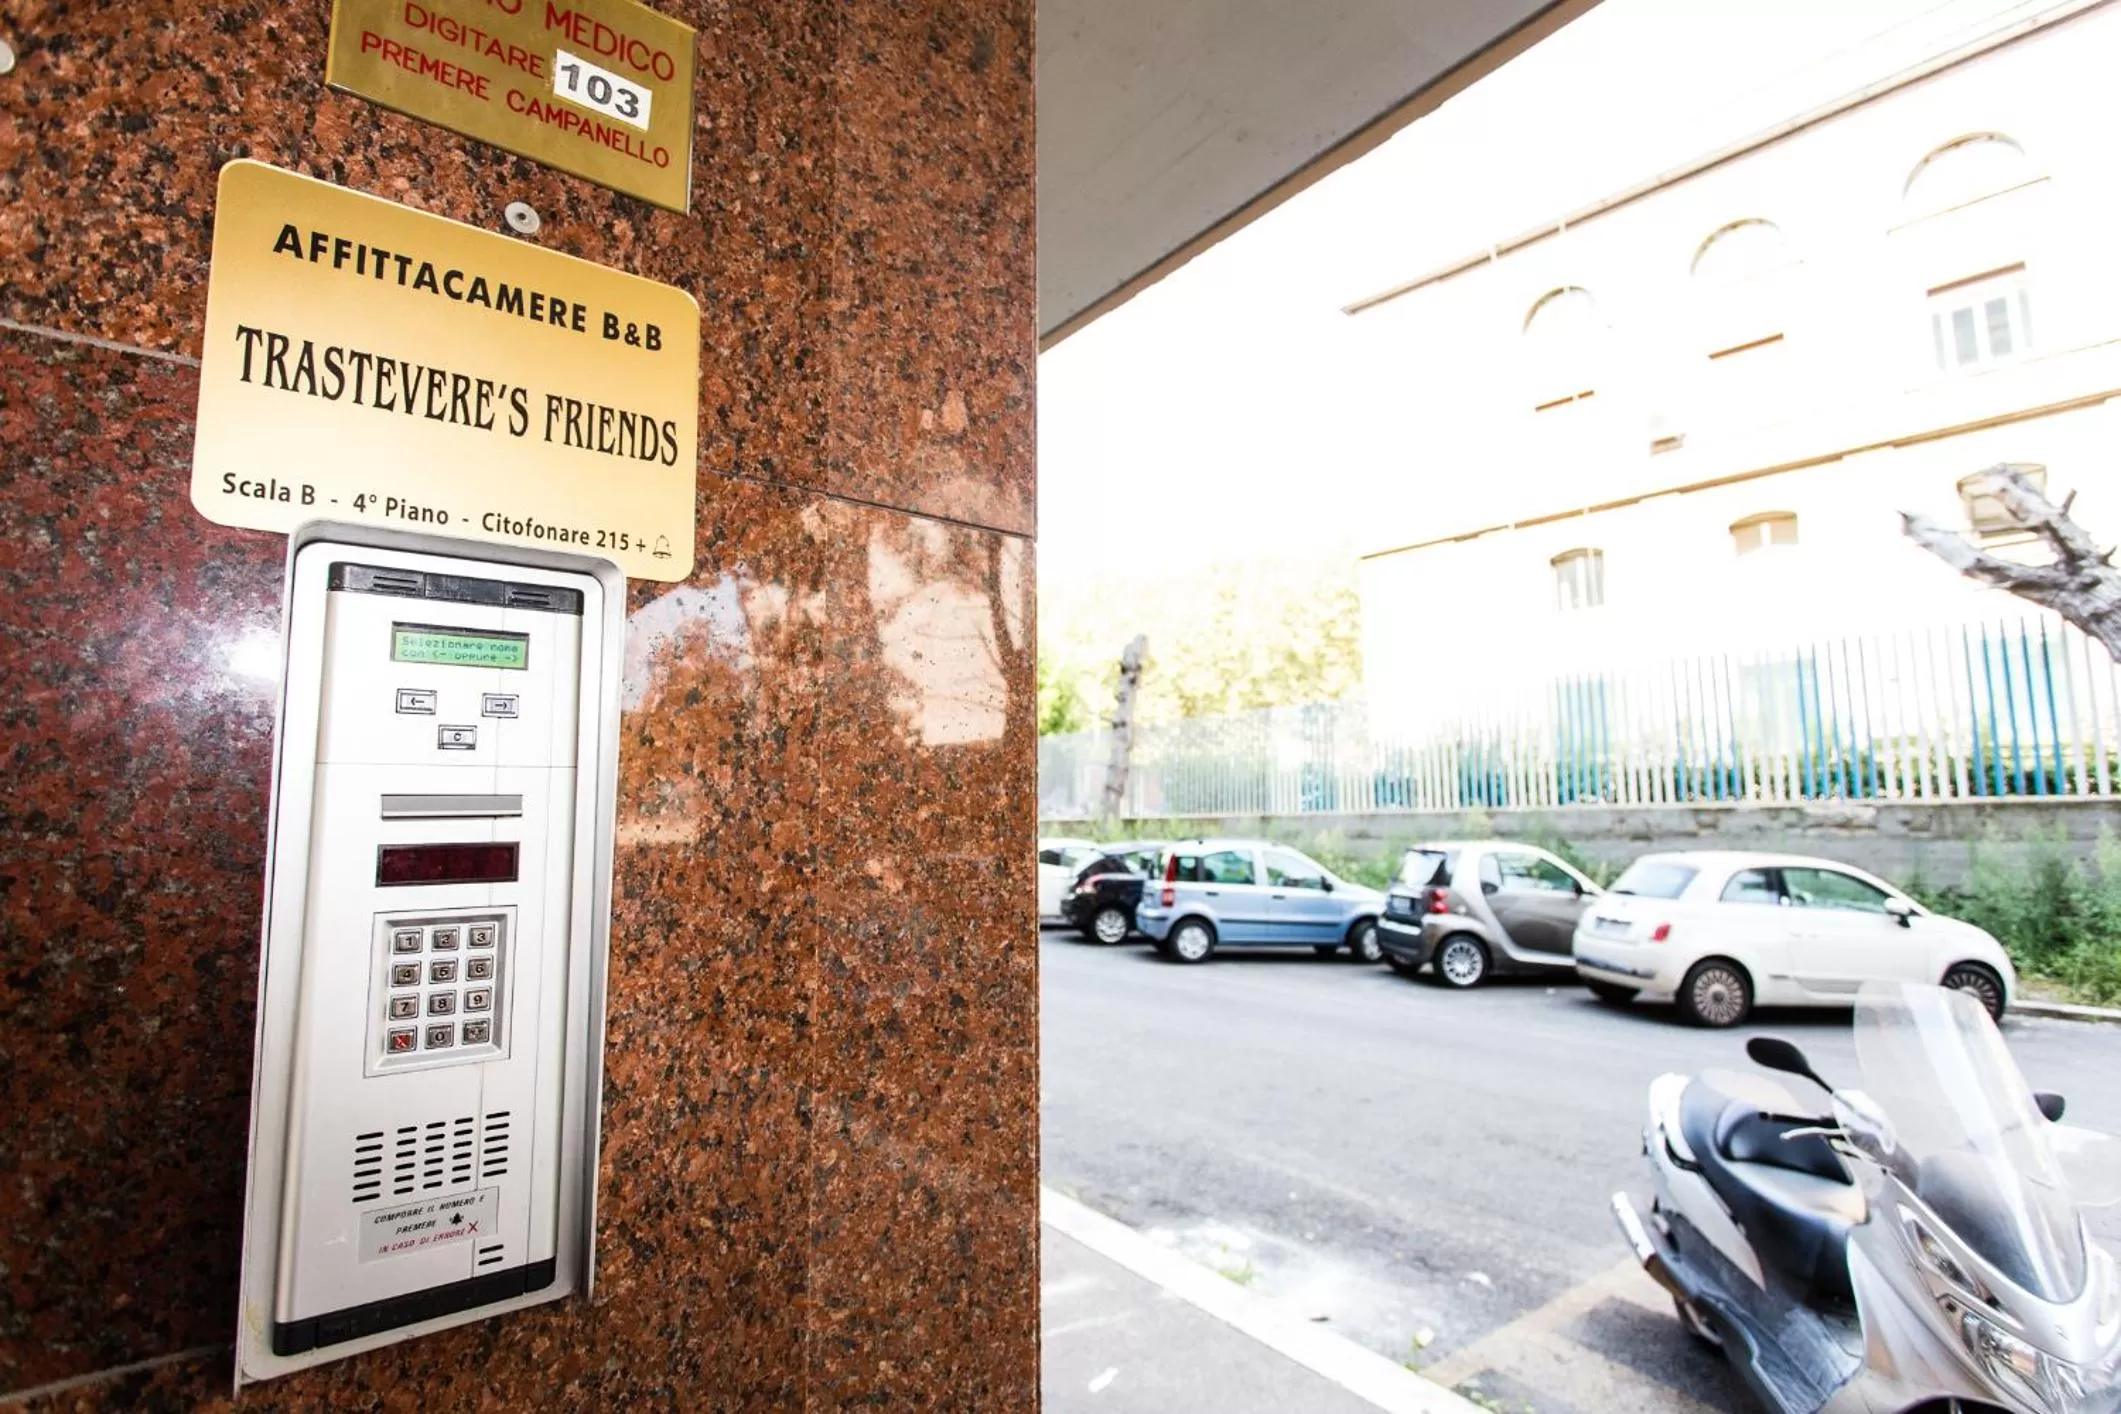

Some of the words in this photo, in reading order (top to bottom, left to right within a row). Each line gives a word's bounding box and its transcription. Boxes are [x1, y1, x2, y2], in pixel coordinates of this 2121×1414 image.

[404, 3, 544, 79] DIGITARE
[561, 63, 639, 118] 103
[545, 1, 675, 81] MEDICO
[361, 31, 491, 100] PREMERE
[507, 89, 669, 168] CAMPANELLO
[273, 225, 586, 332] AFFITTACAMERE
[603, 313, 662, 351] B&B
[236, 324, 528, 437] TRASTEVERE'S
[544, 395, 678, 466] FRIENDS
[223, 472, 291, 503] Scala
[301, 484, 315, 506] B
[386, 498, 449, 525] Piano
[482, 512, 589, 546] Citofonare
[597, 529, 629, 552] 215
[477, 932, 486, 942] 3
[401, 1002, 409, 1012] 7
[438, 999, 447, 1008] 8
[473, 994, 482, 1004] 9
